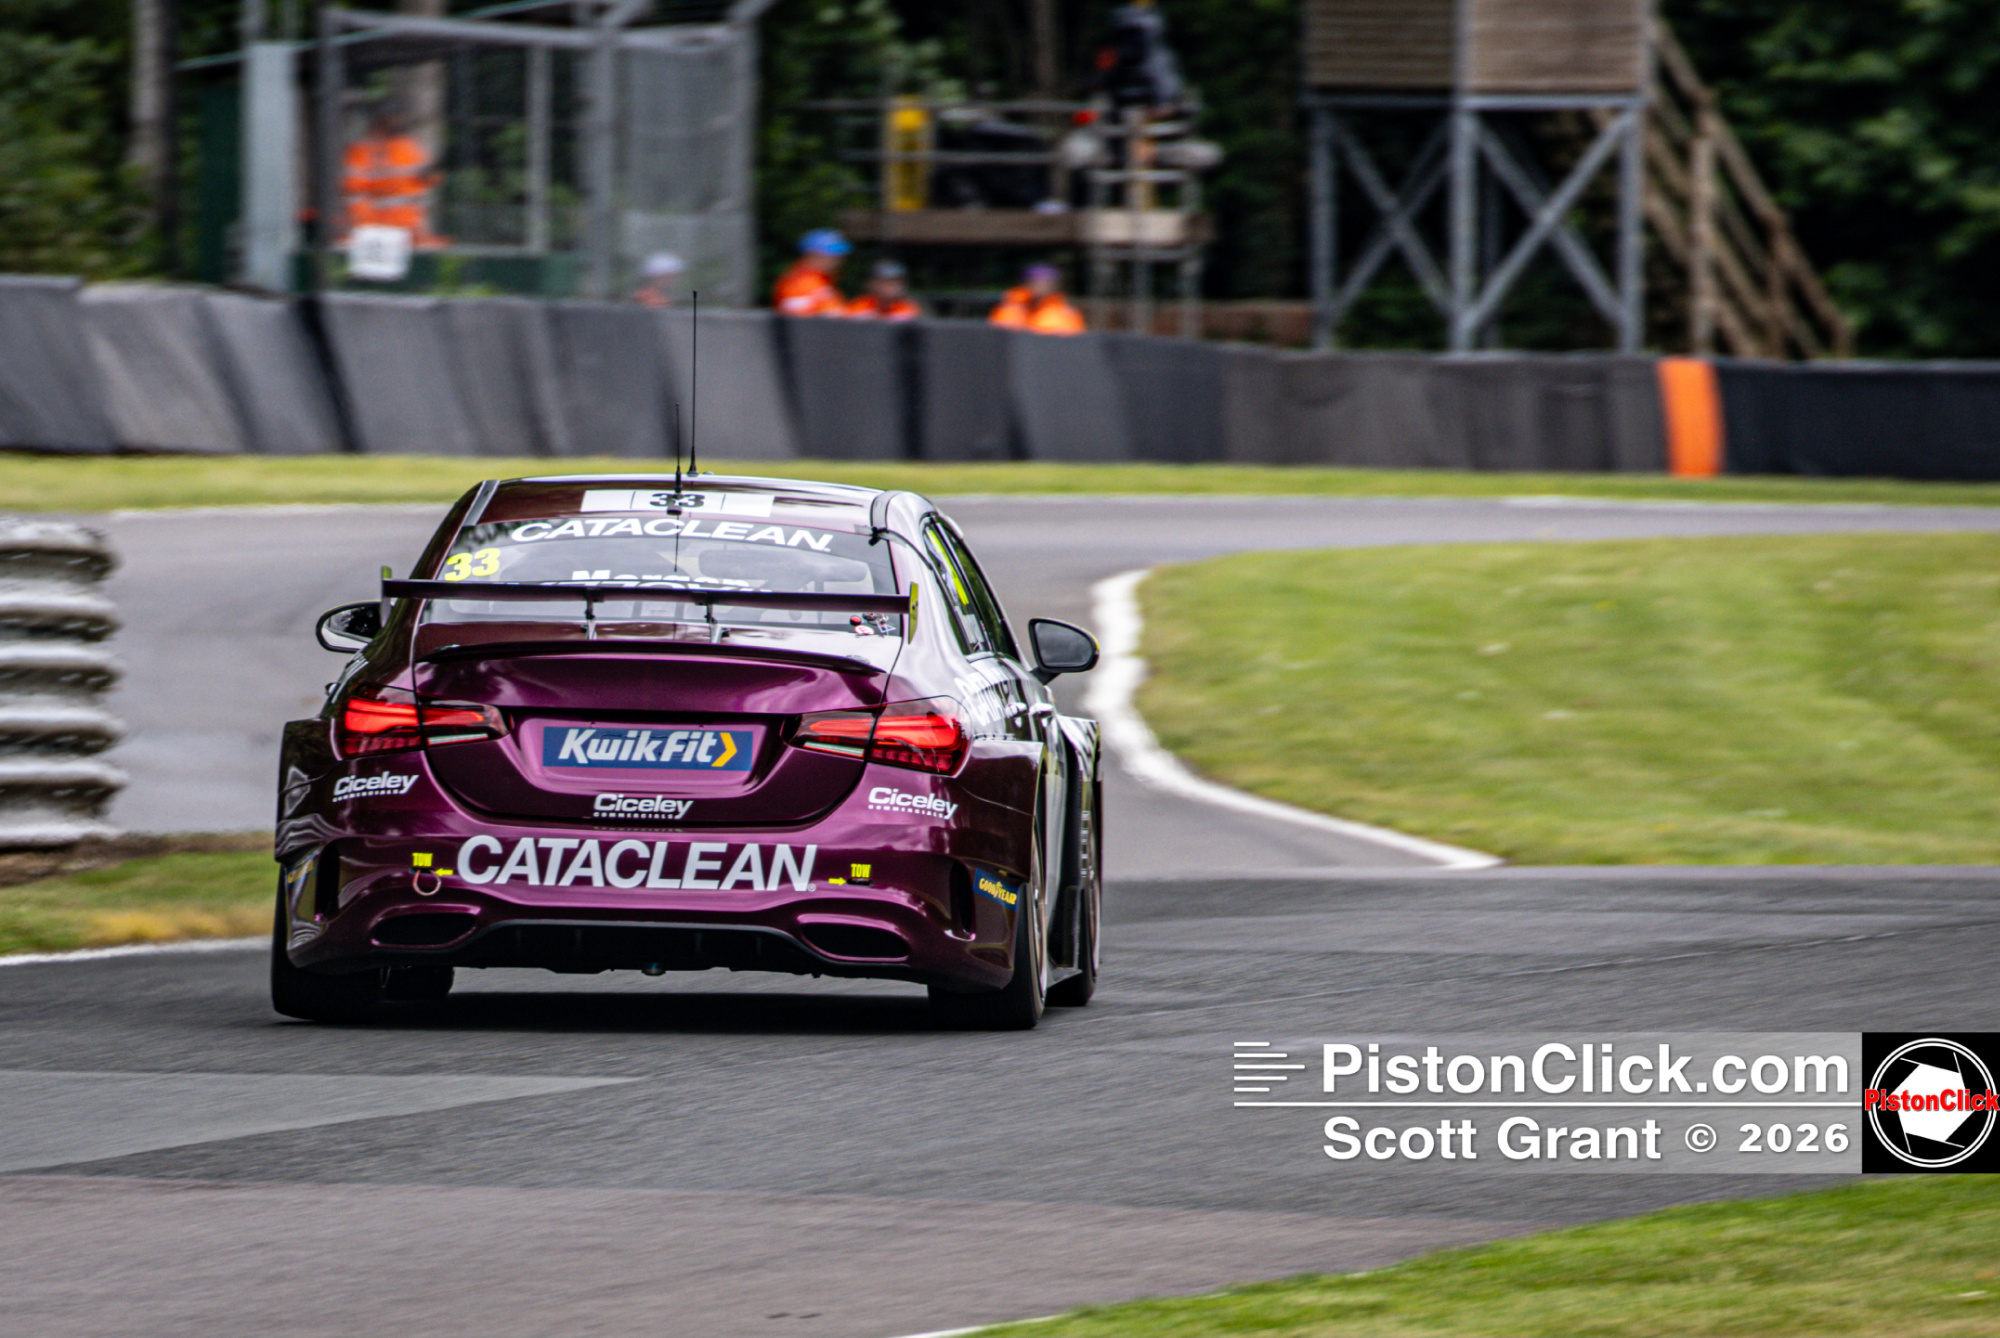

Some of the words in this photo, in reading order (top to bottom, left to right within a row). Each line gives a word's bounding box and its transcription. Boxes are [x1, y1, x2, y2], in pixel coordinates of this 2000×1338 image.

[650, 493, 705, 508] 33
[511, 518, 834, 551] CATACLEAN
[444, 547, 500, 581] 33
[333, 771, 419, 796] Ciceley
[593, 793, 694, 819] Ciceley
[868, 787, 958, 820] Ciceley
[412, 853, 433, 867] TOW
[851, 864, 871, 878] TOW
